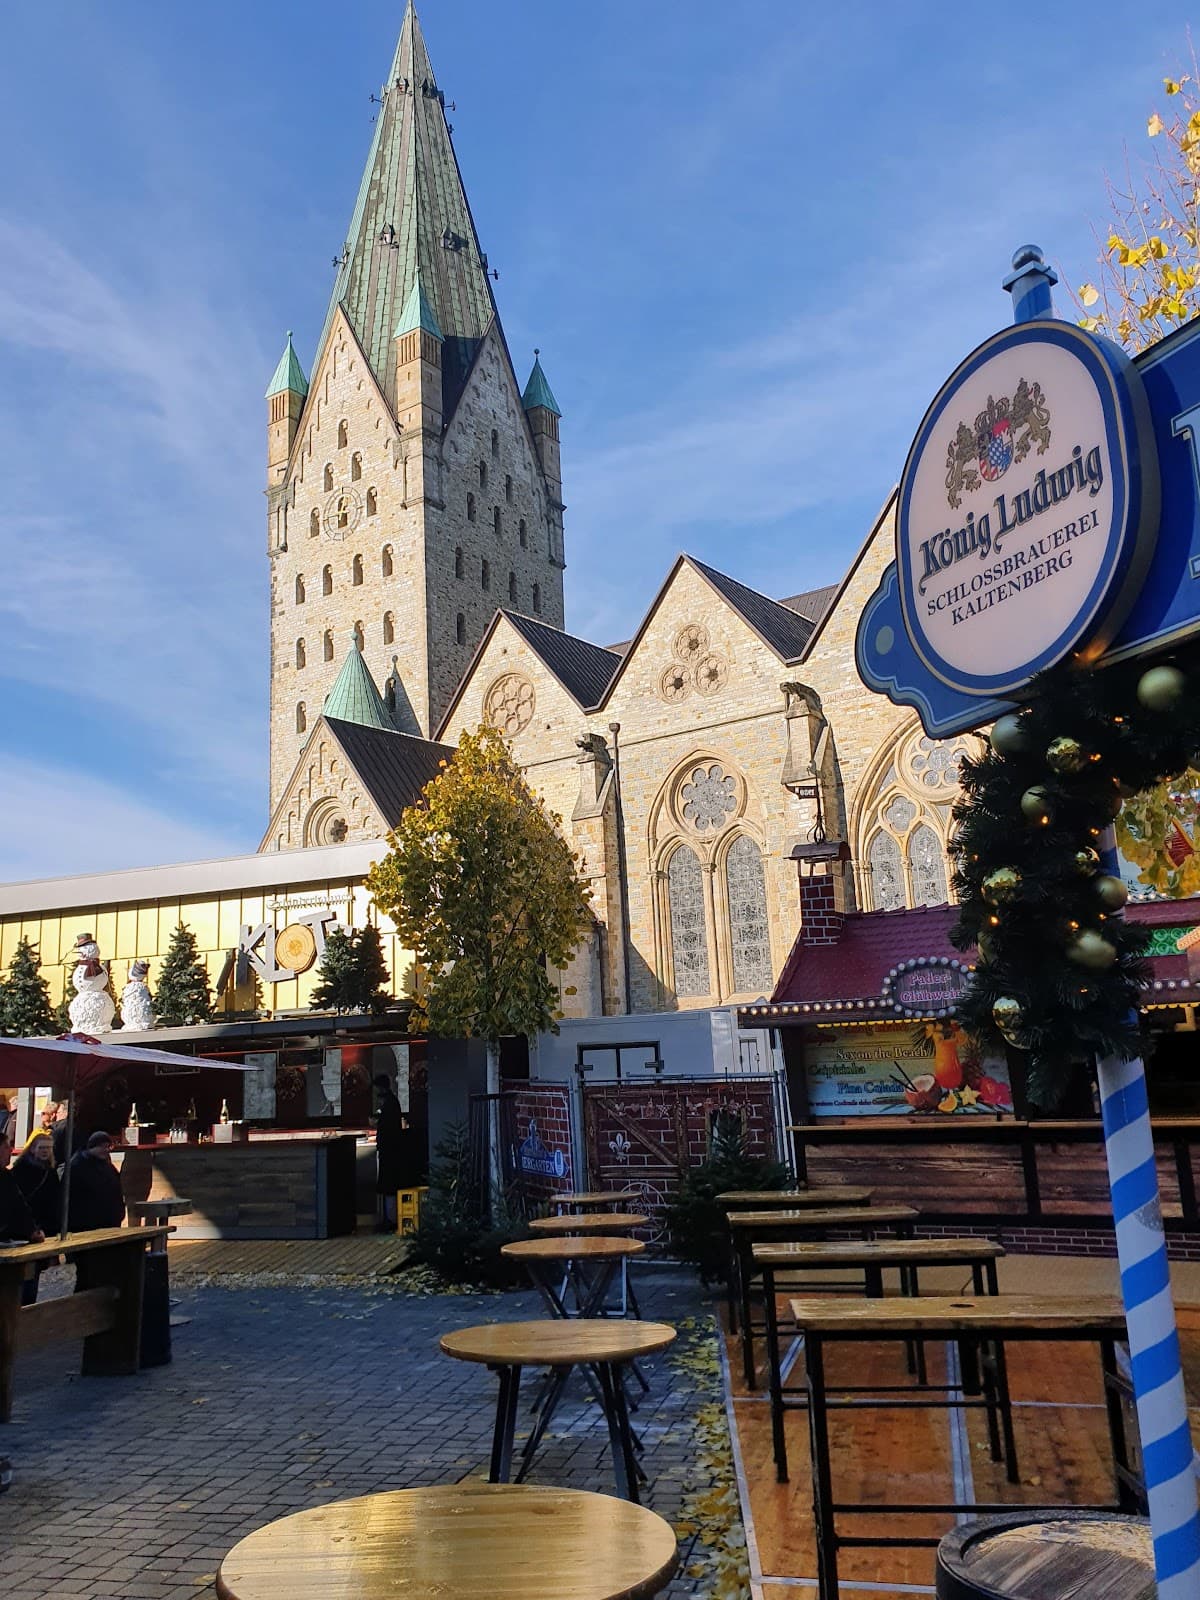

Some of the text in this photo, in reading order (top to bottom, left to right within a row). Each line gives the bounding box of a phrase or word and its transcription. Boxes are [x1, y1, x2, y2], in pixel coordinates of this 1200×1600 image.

[918, 511, 992, 597] König
[993, 445, 1104, 555] Ludwig
[927, 509, 1100, 616] SCHLOSSBRAUEREI
[951, 549, 1073, 626] KALTENBERG
